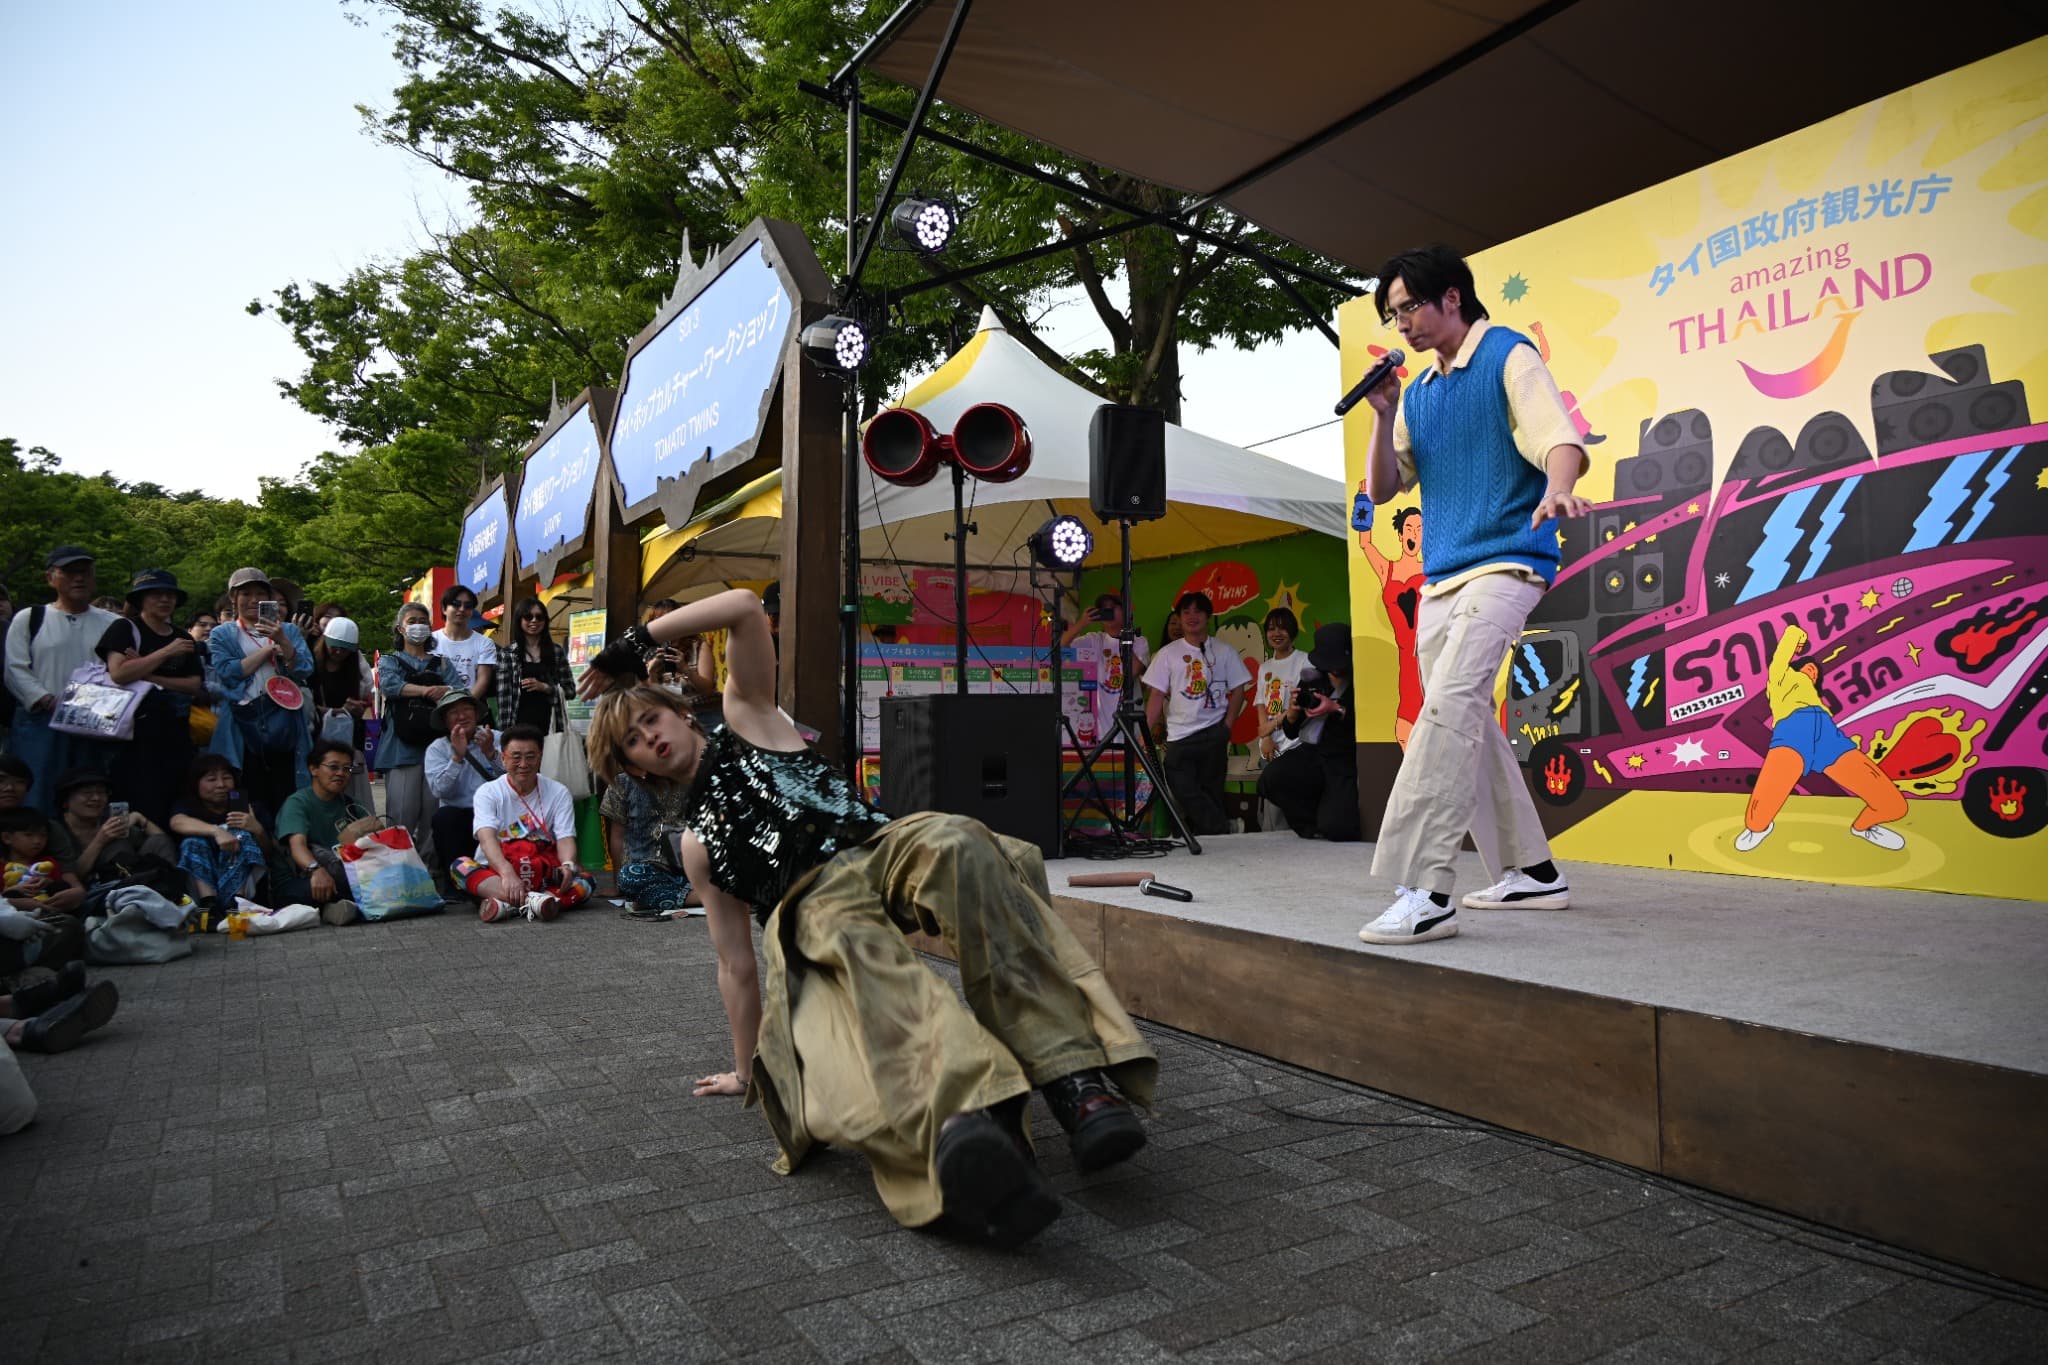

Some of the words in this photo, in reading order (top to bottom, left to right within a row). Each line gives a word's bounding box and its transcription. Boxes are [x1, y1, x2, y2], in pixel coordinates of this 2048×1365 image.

[1648, 172, 1952, 296] タイ国政府観光庁
[1730, 241, 1852, 294] amazing
[1669, 252, 1933, 354] THAILAND
[654, 423, 687, 463] TOMATO
[689, 401, 720, 440] TWINS
[872, 575, 900, 587] VIBE
[1217, 584, 1248, 601] TWINS
[1673, 688, 1742, 718] 1212312121
[519, 856, 535, 892] adi
